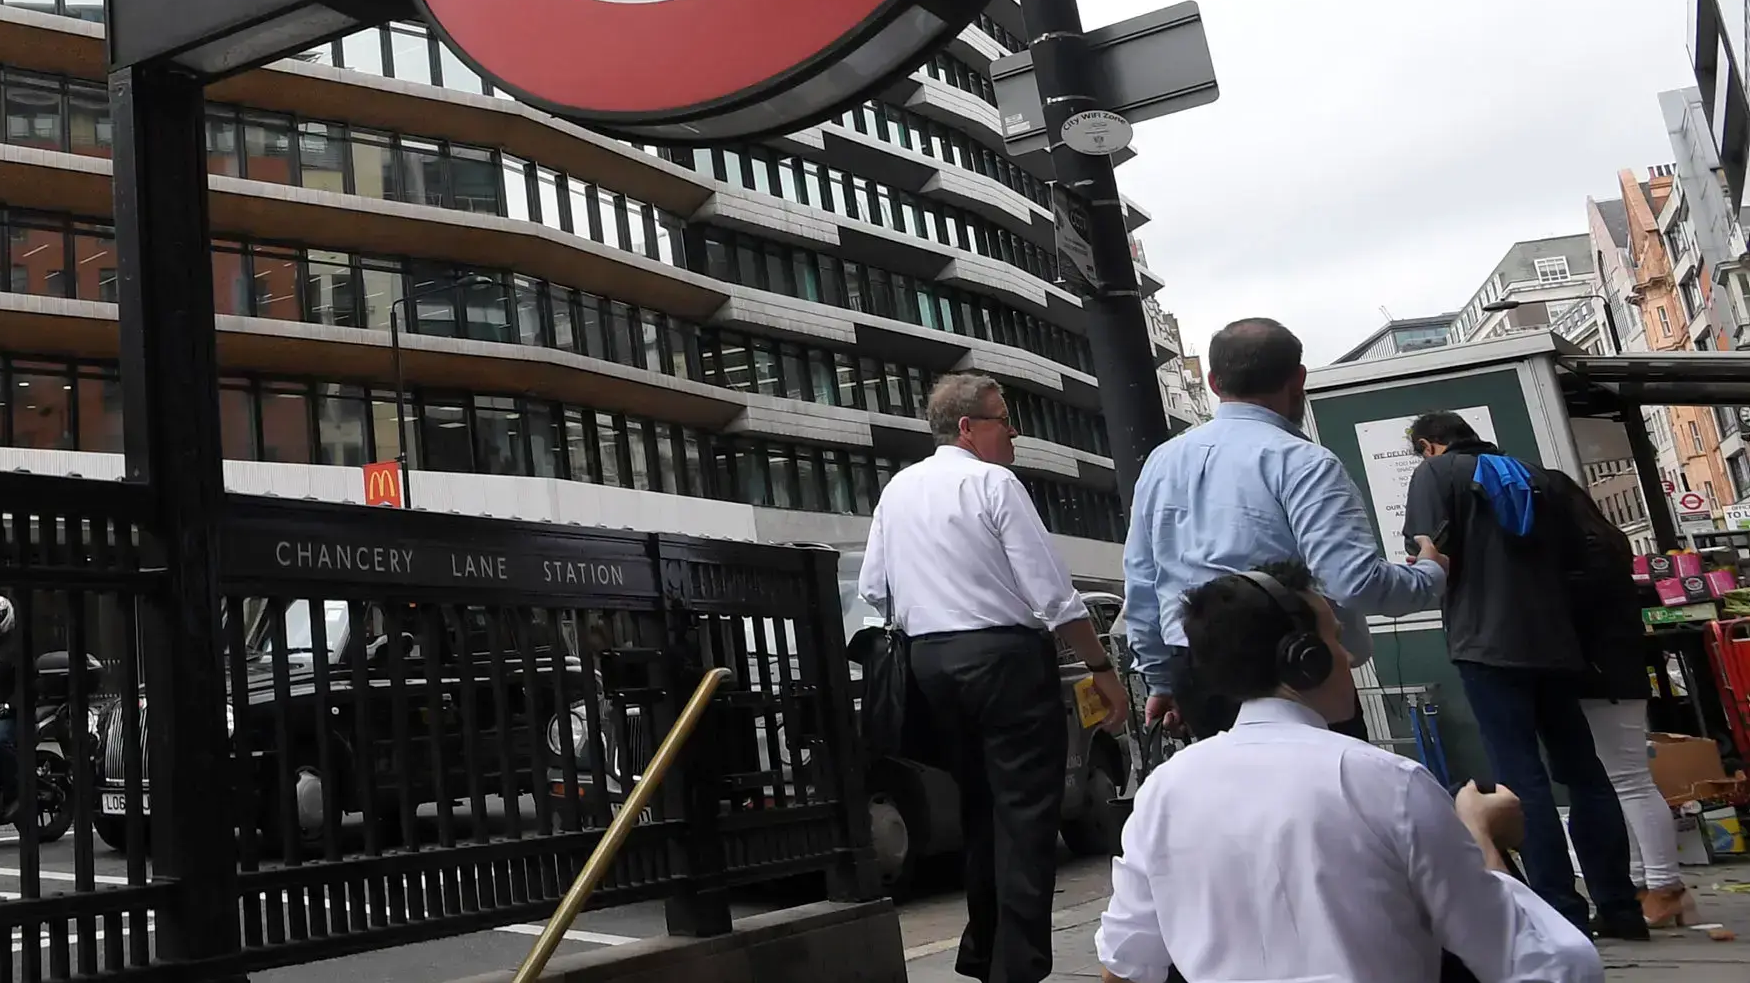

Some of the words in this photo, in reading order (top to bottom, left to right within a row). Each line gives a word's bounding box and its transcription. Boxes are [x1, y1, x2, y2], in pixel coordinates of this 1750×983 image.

[275, 541, 414, 574] CHANCERY
[451, 553, 508, 579] LANE
[544, 560, 624, 586] STATION
